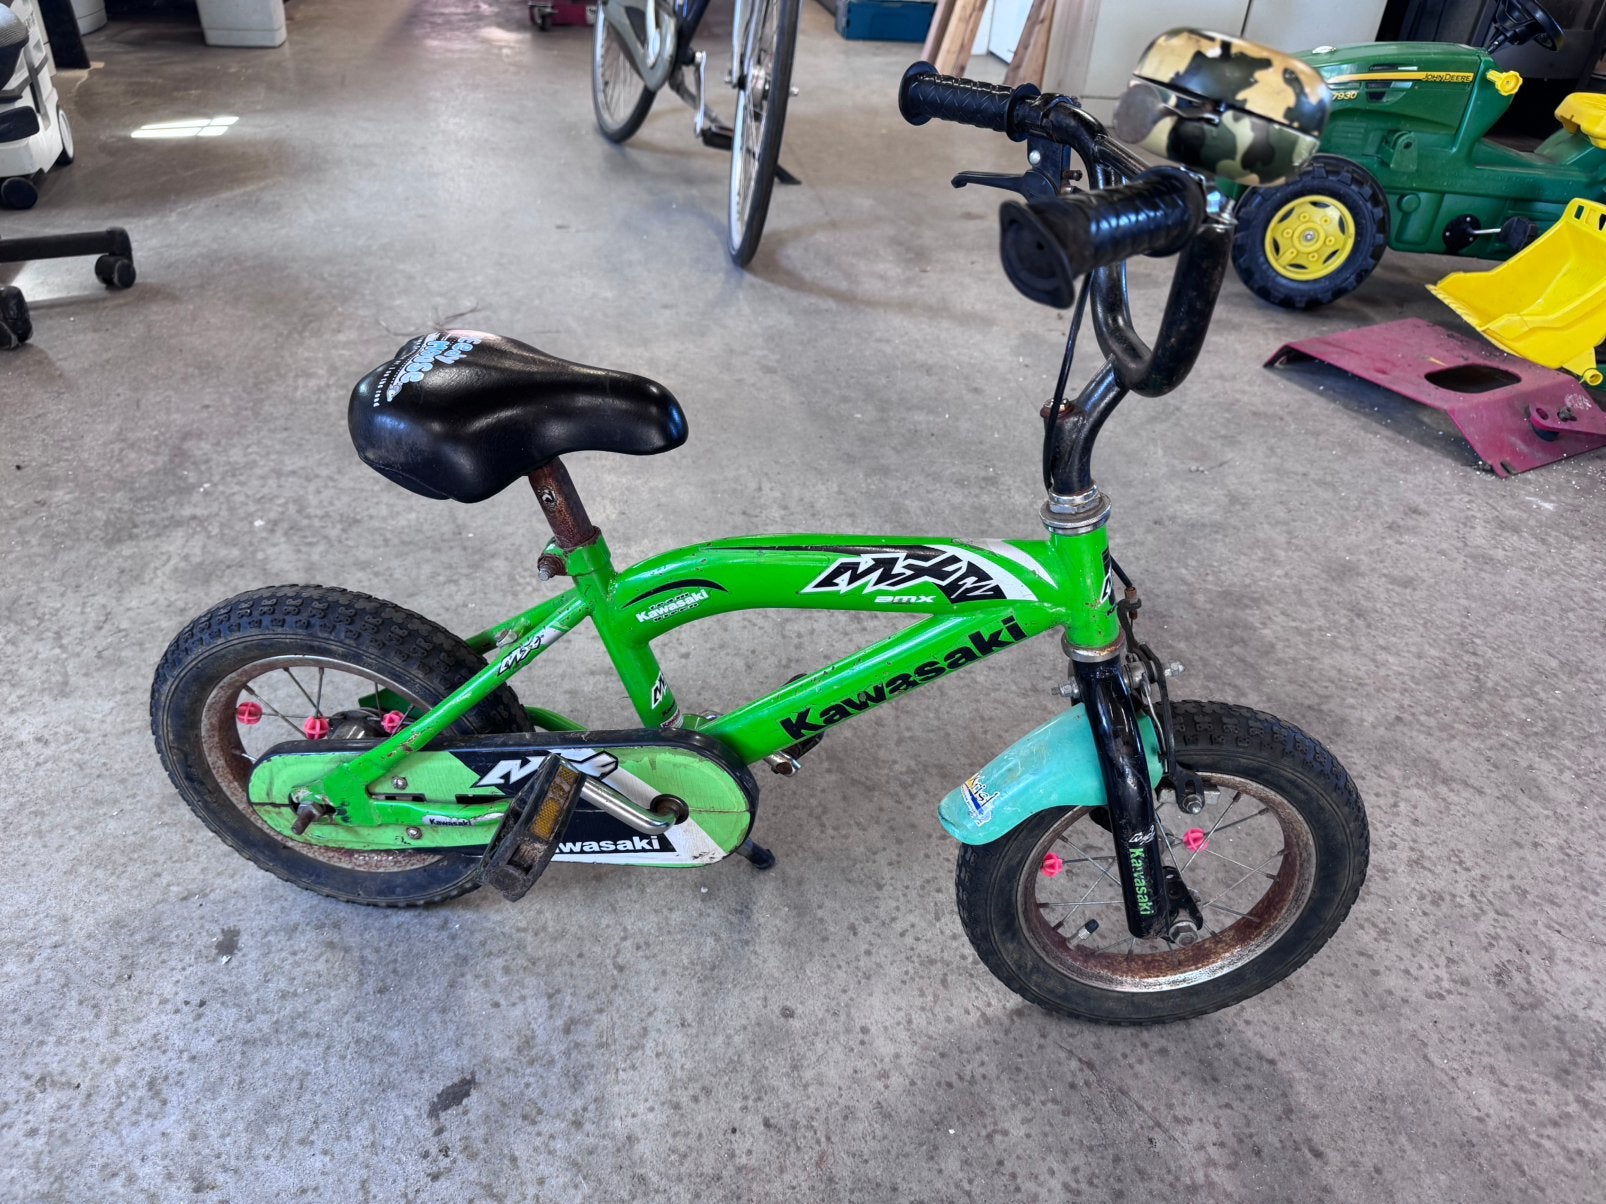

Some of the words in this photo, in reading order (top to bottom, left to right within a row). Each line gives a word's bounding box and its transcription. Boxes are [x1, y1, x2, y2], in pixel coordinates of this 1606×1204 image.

[1421, 73, 1444, 82] JOHN
[1444, 73, 1471, 81] DEERE
[1332, 90, 1358, 100] 7930
[636, 588, 709, 623] Kawasaki
[779, 614, 1028, 741] Kawasaki
[429, 818, 472, 827] Kawasaki
[555, 836, 660, 853] wasaki
[1129, 848, 1154, 915] Kawasaki
